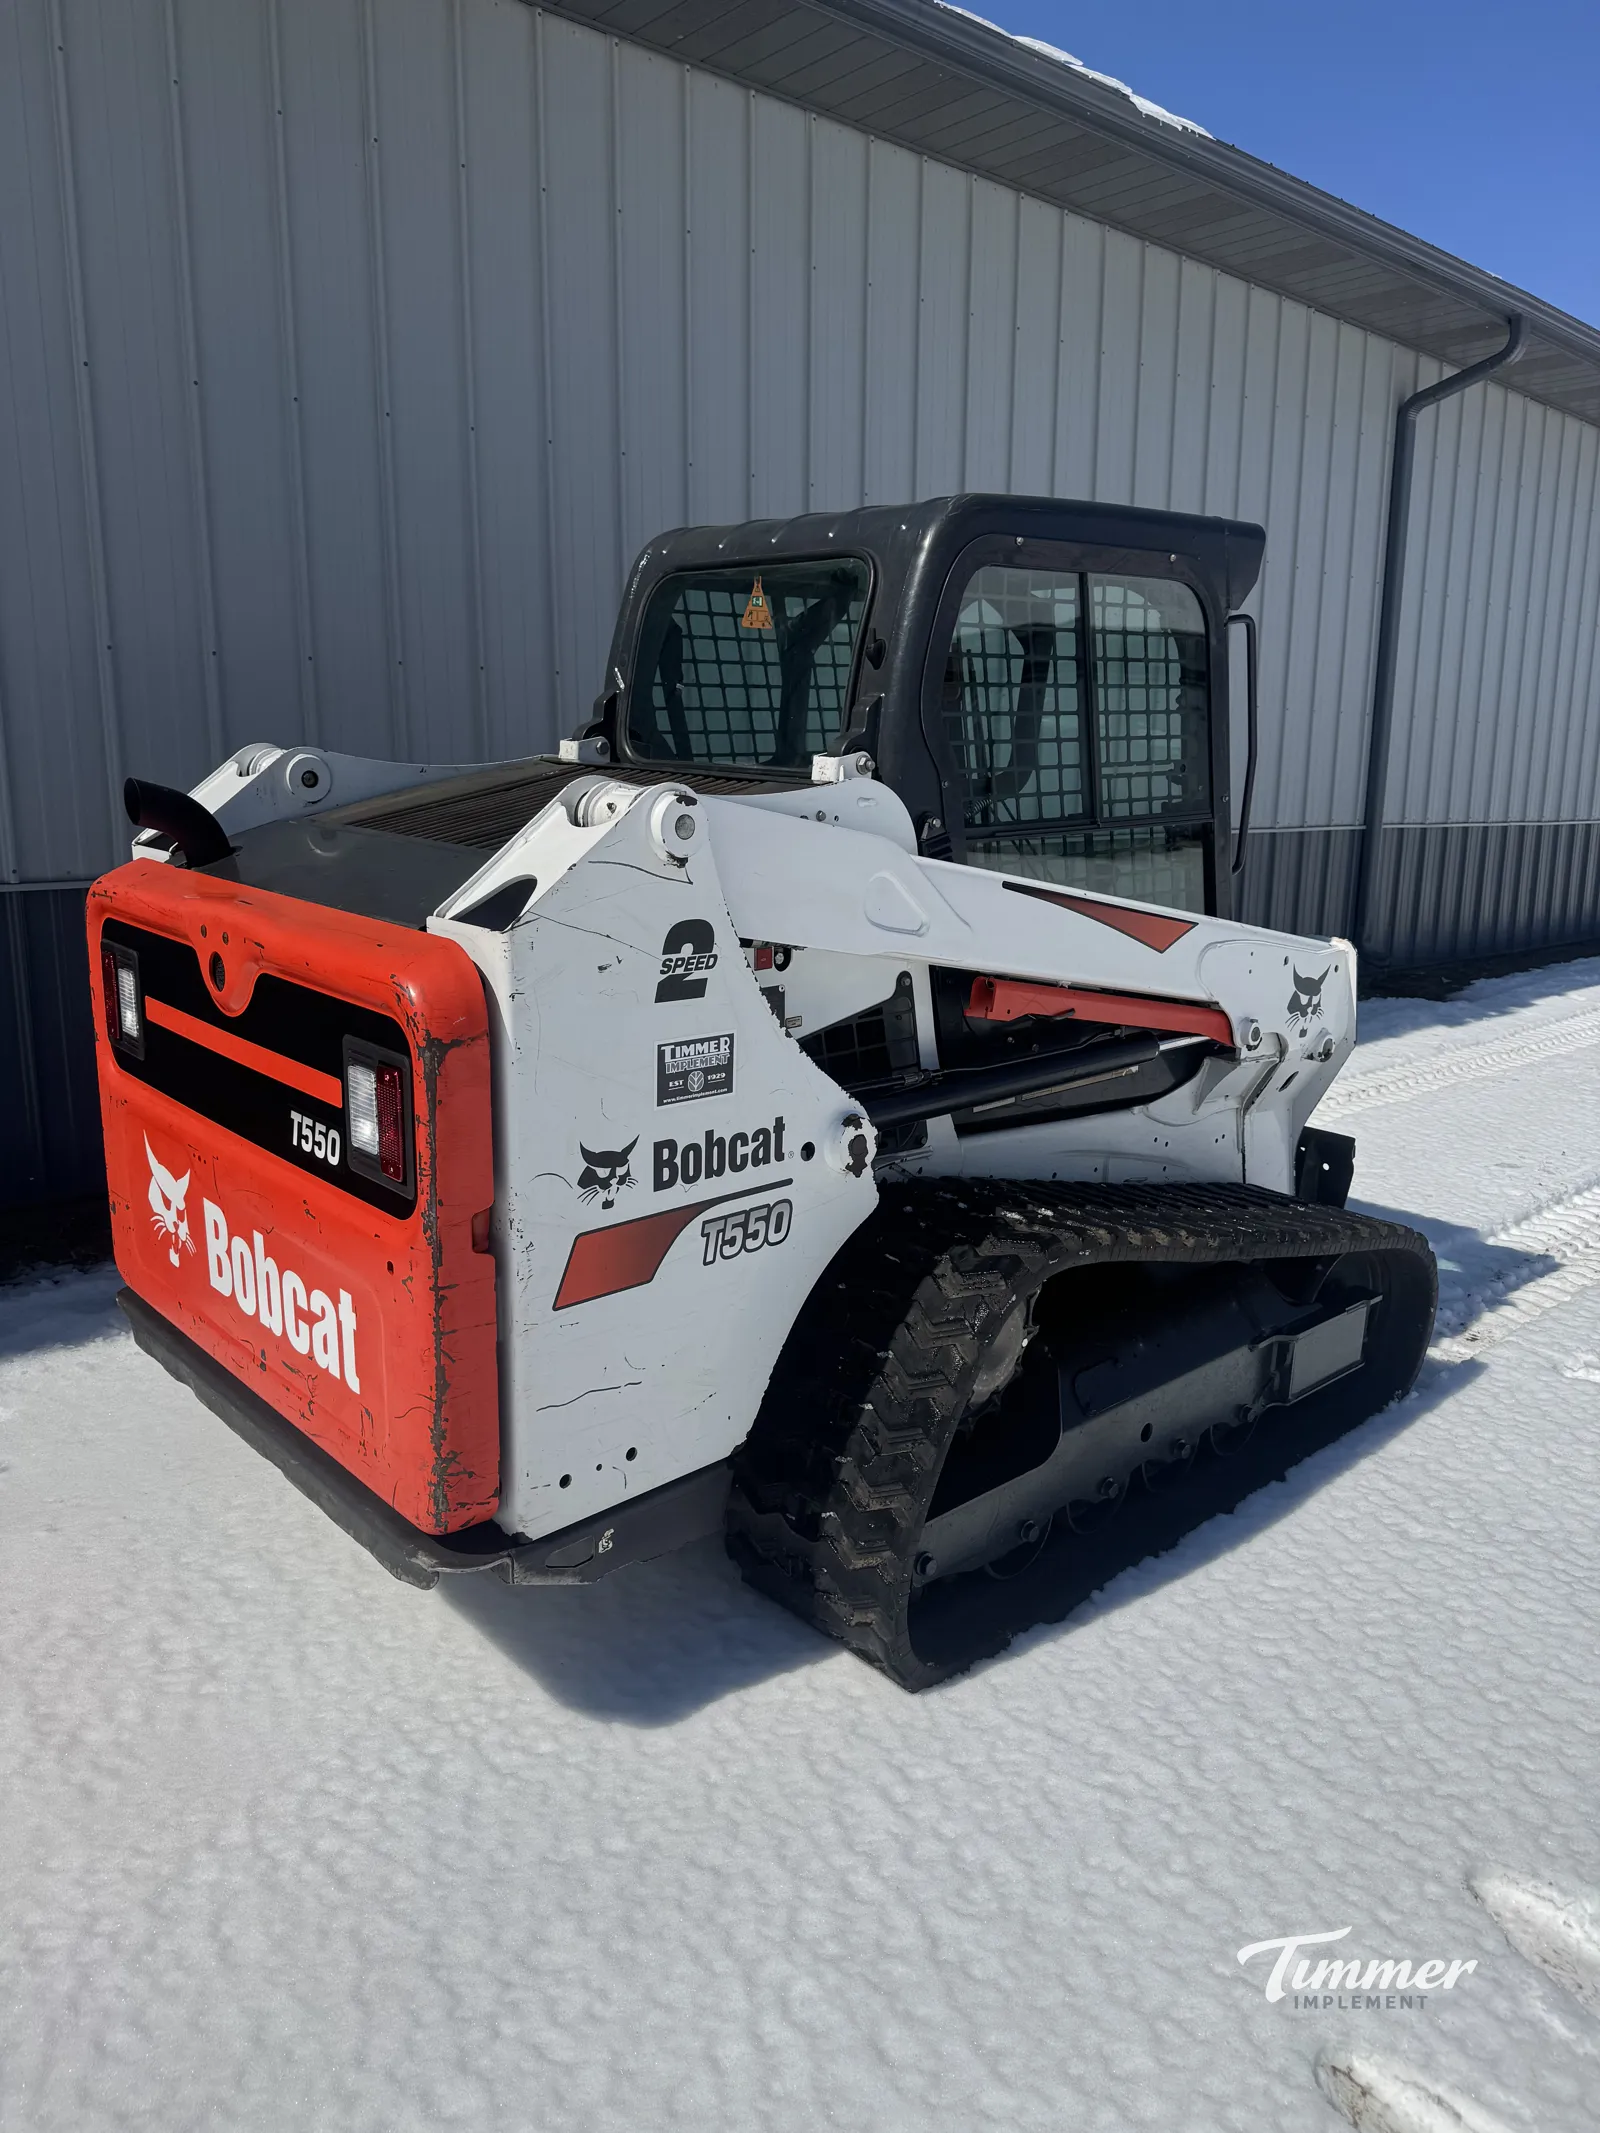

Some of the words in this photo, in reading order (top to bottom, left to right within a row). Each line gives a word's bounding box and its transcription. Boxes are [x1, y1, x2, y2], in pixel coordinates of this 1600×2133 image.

[654, 918, 715, 1004] 2
[659, 953, 719, 976] SPEED
[660, 1036, 731, 1063] TIMMER
[665, 1052, 731, 1074] IMPLEMENT
[668, 1079, 684, 1088] EST
[707, 1072, 727, 1081] 1929
[290, 1110, 341, 1167] T550
[653, 1115, 786, 1193] Bobcat
[700, 1198, 794, 1267] T550
[203, 1197, 361, 1396] Bobcat
